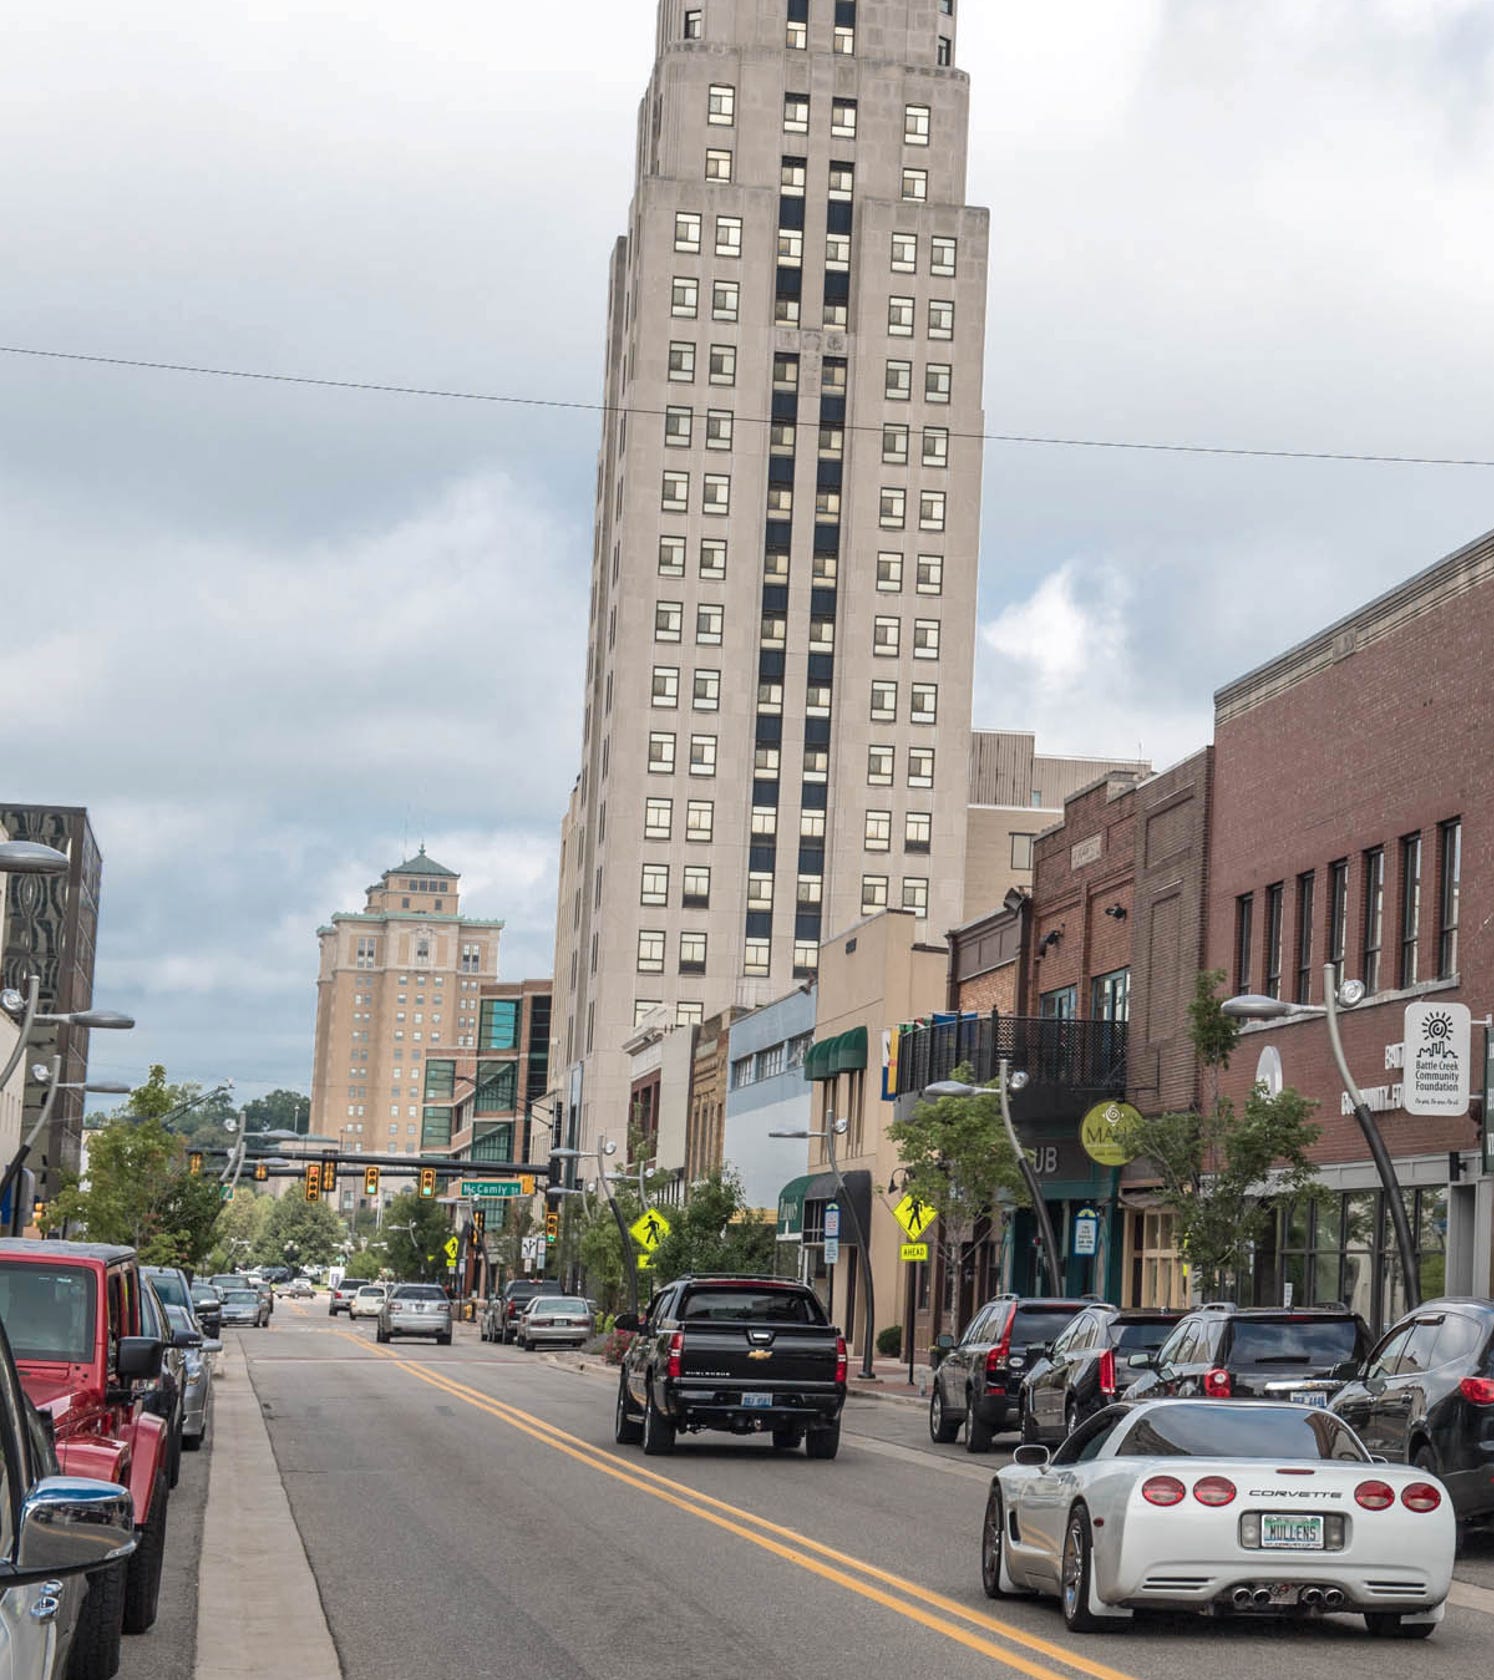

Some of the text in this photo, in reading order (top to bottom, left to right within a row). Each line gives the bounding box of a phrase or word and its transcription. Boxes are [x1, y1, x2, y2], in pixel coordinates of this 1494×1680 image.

[1416, 1061, 1459, 1072] Battle Creek
[1415, 1071, 1460, 1084] Community
[1416, 1081, 1459, 1092] Foundation
[903, 1246, 924, 1256] AHEAD
[1249, 1489, 1342, 1499] CORVETTE
[1270, 1525, 1316, 1542] MULLENS
